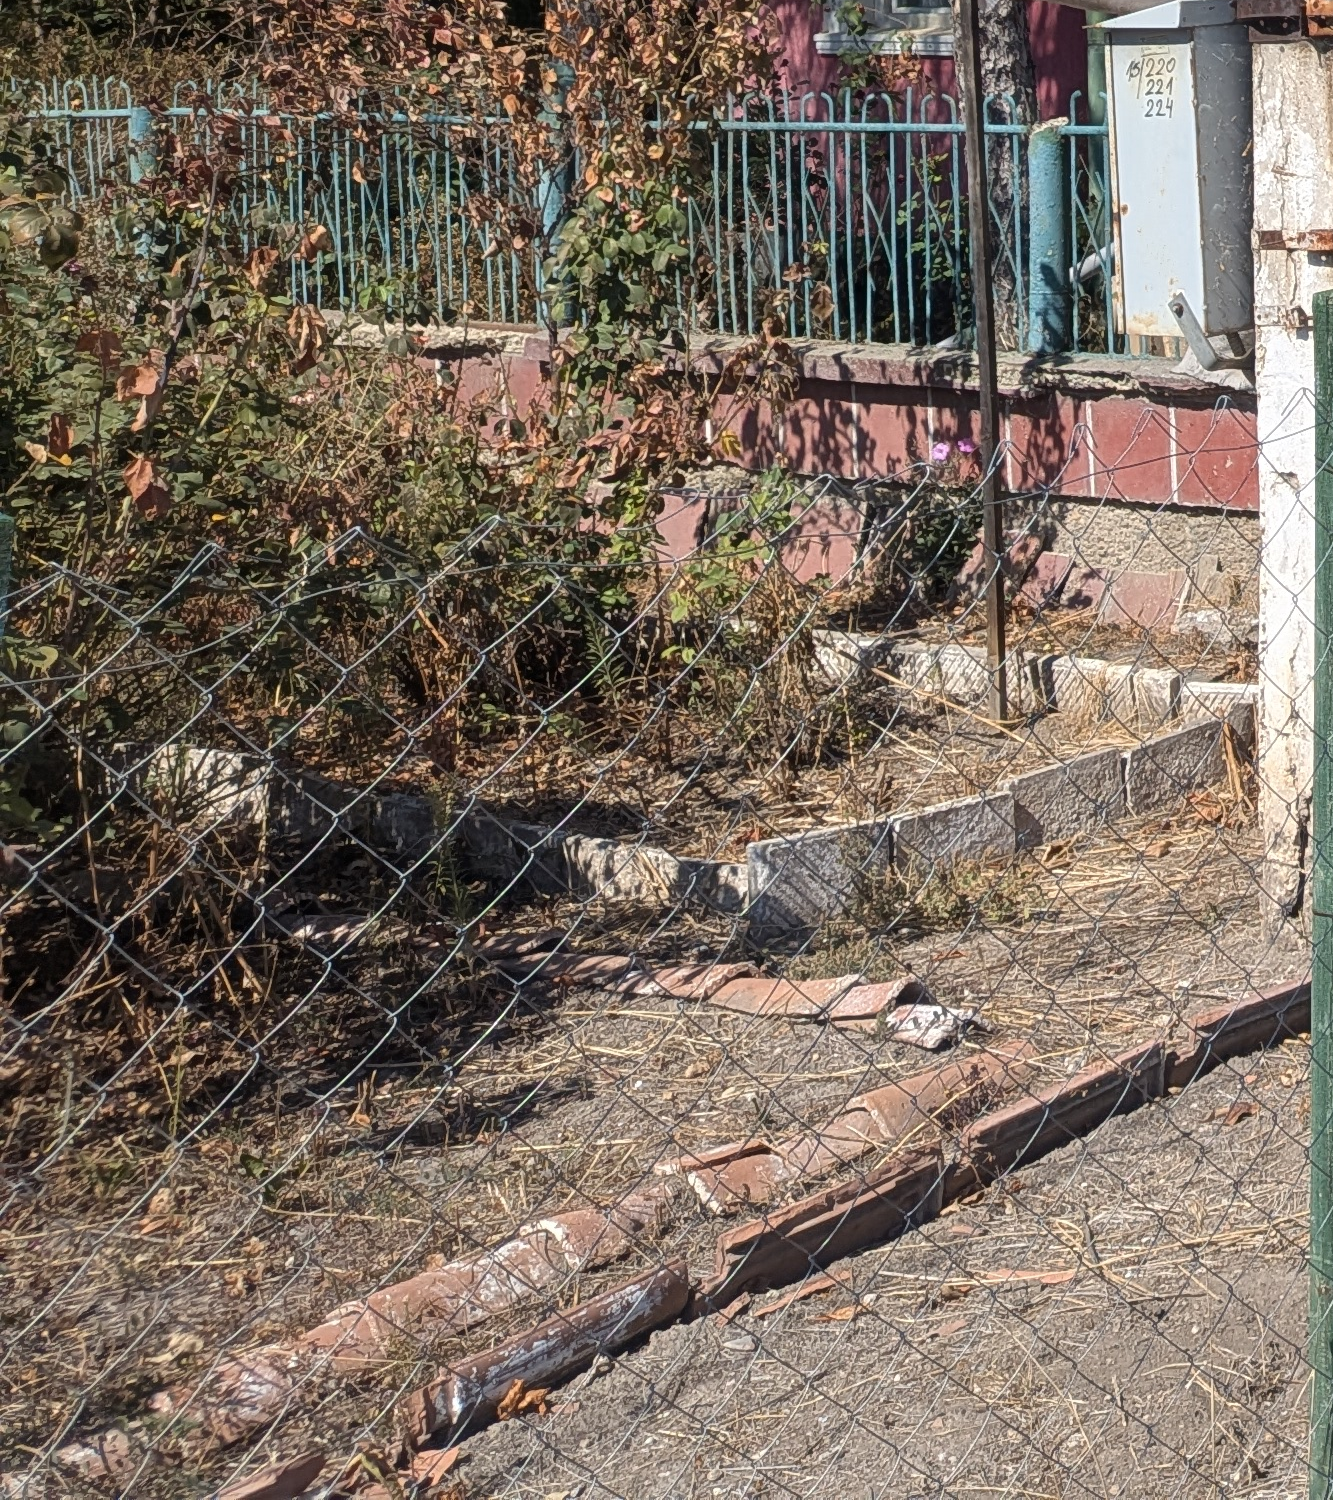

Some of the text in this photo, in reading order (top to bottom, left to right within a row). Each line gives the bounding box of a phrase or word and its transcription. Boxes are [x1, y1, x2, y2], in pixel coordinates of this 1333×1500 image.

[1126, 57, 1176, 99] 15/220
[1145, 76, 1174, 96] 221
[1144, 97, 1174, 119] 224
